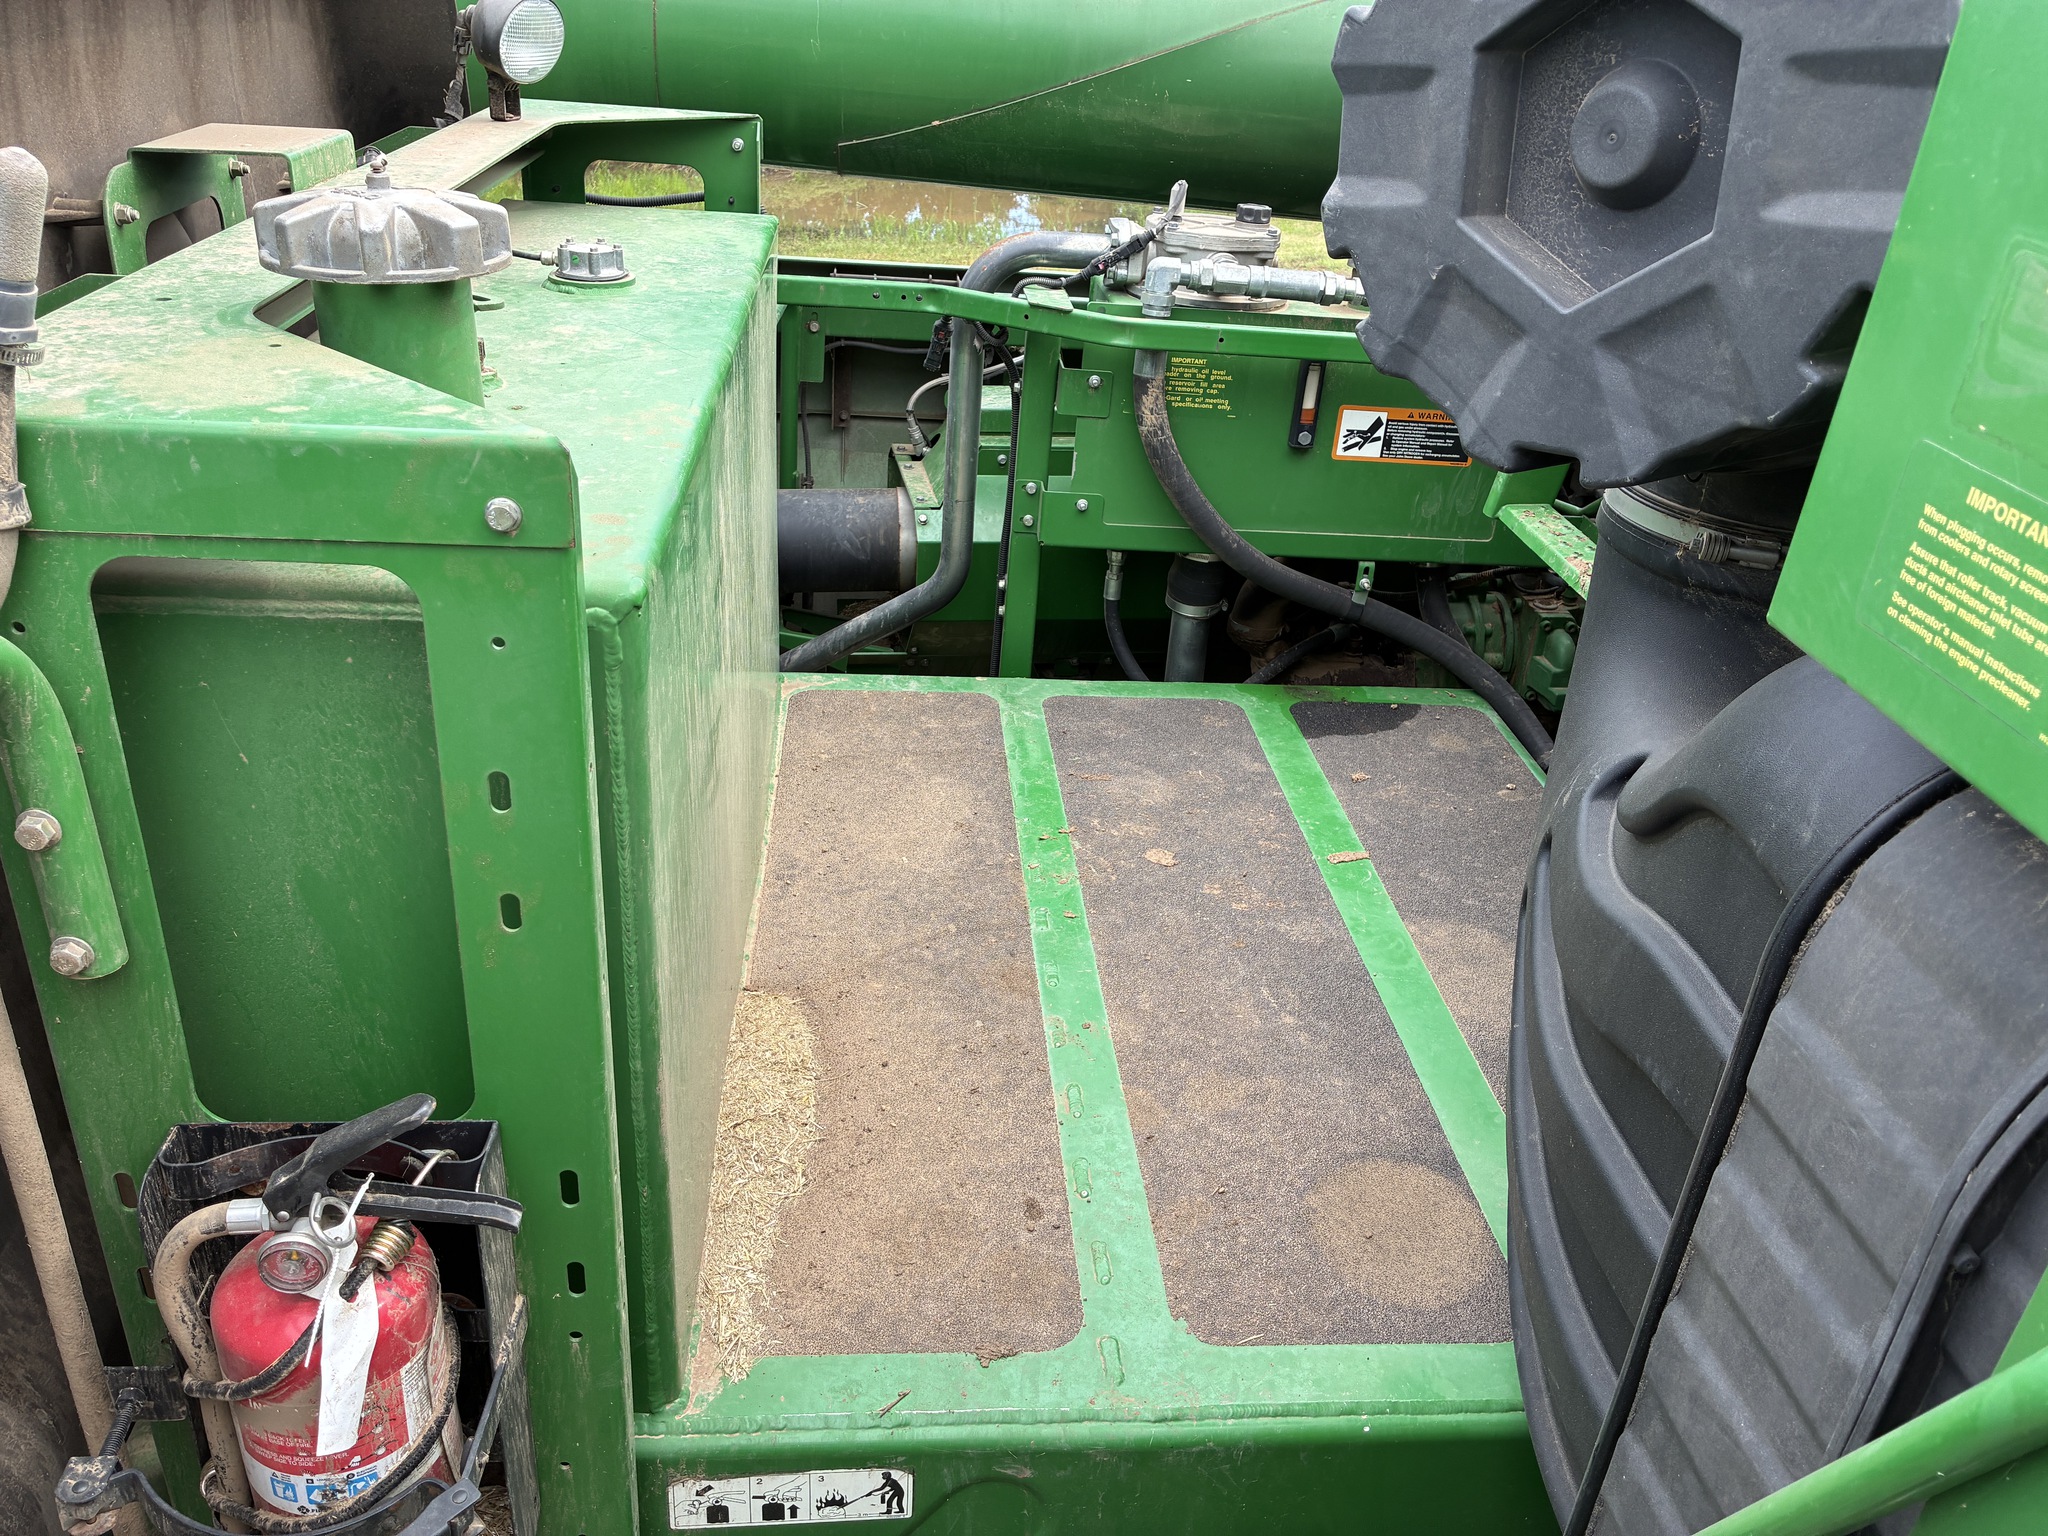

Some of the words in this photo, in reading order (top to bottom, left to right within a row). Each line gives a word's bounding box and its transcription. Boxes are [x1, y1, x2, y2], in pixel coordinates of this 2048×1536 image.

[1171, 357, 1207, 365] IMPORTANT
[1418, 412, 1450, 421] WARNI
[1917, 518, 1938, 538] from
[1937, 532, 1971, 557] coolers
[1970, 551, 1991, 568] and
[1989, 562, 2019, 587] rotary
[1923, 503, 1948, 525] When
[1946, 519, 1987, 551] plugging
[1985, 543, 2021, 571] occurs,
[2022, 563, 2048, 585] remo
[1966, 487, 2048, 548] IMPORTAN
[1899, 568, 1917, 587] free
[1916, 581, 1928, 593] of
[1926, 585, 1957, 613] foreign
[1957, 607, 1996, 639] material.
[1904, 556, 1928, 577] ducts
[1927, 571, 1946, 588] and
[1944, 582, 1990, 615] aircleaner
[1989, 608, 2013, 631] inlet
[2011, 622, 2035, 645] tube
[1909, 541, 1941, 567] Assure
[1939, 559, 1958, 578] that
[1957, 572, 1983, 592] roller
[1982, 585, 2008, 612] track,
[2010, 604, 2048, 635] vacuum
[1887, 606, 1900, 618] on
[1898, 614, 1934, 644] cleaning
[1933, 635, 1949, 653] the
[1948, 648, 1980, 674] engine
[1978, 669, 2030, 711] precleaner.
[1891, 590, 1908, 608] See
[1907, 603, 1950, 636] operator's
[1950, 631, 1985, 659] manual
[1984, 652, 2041, 698] instructions
